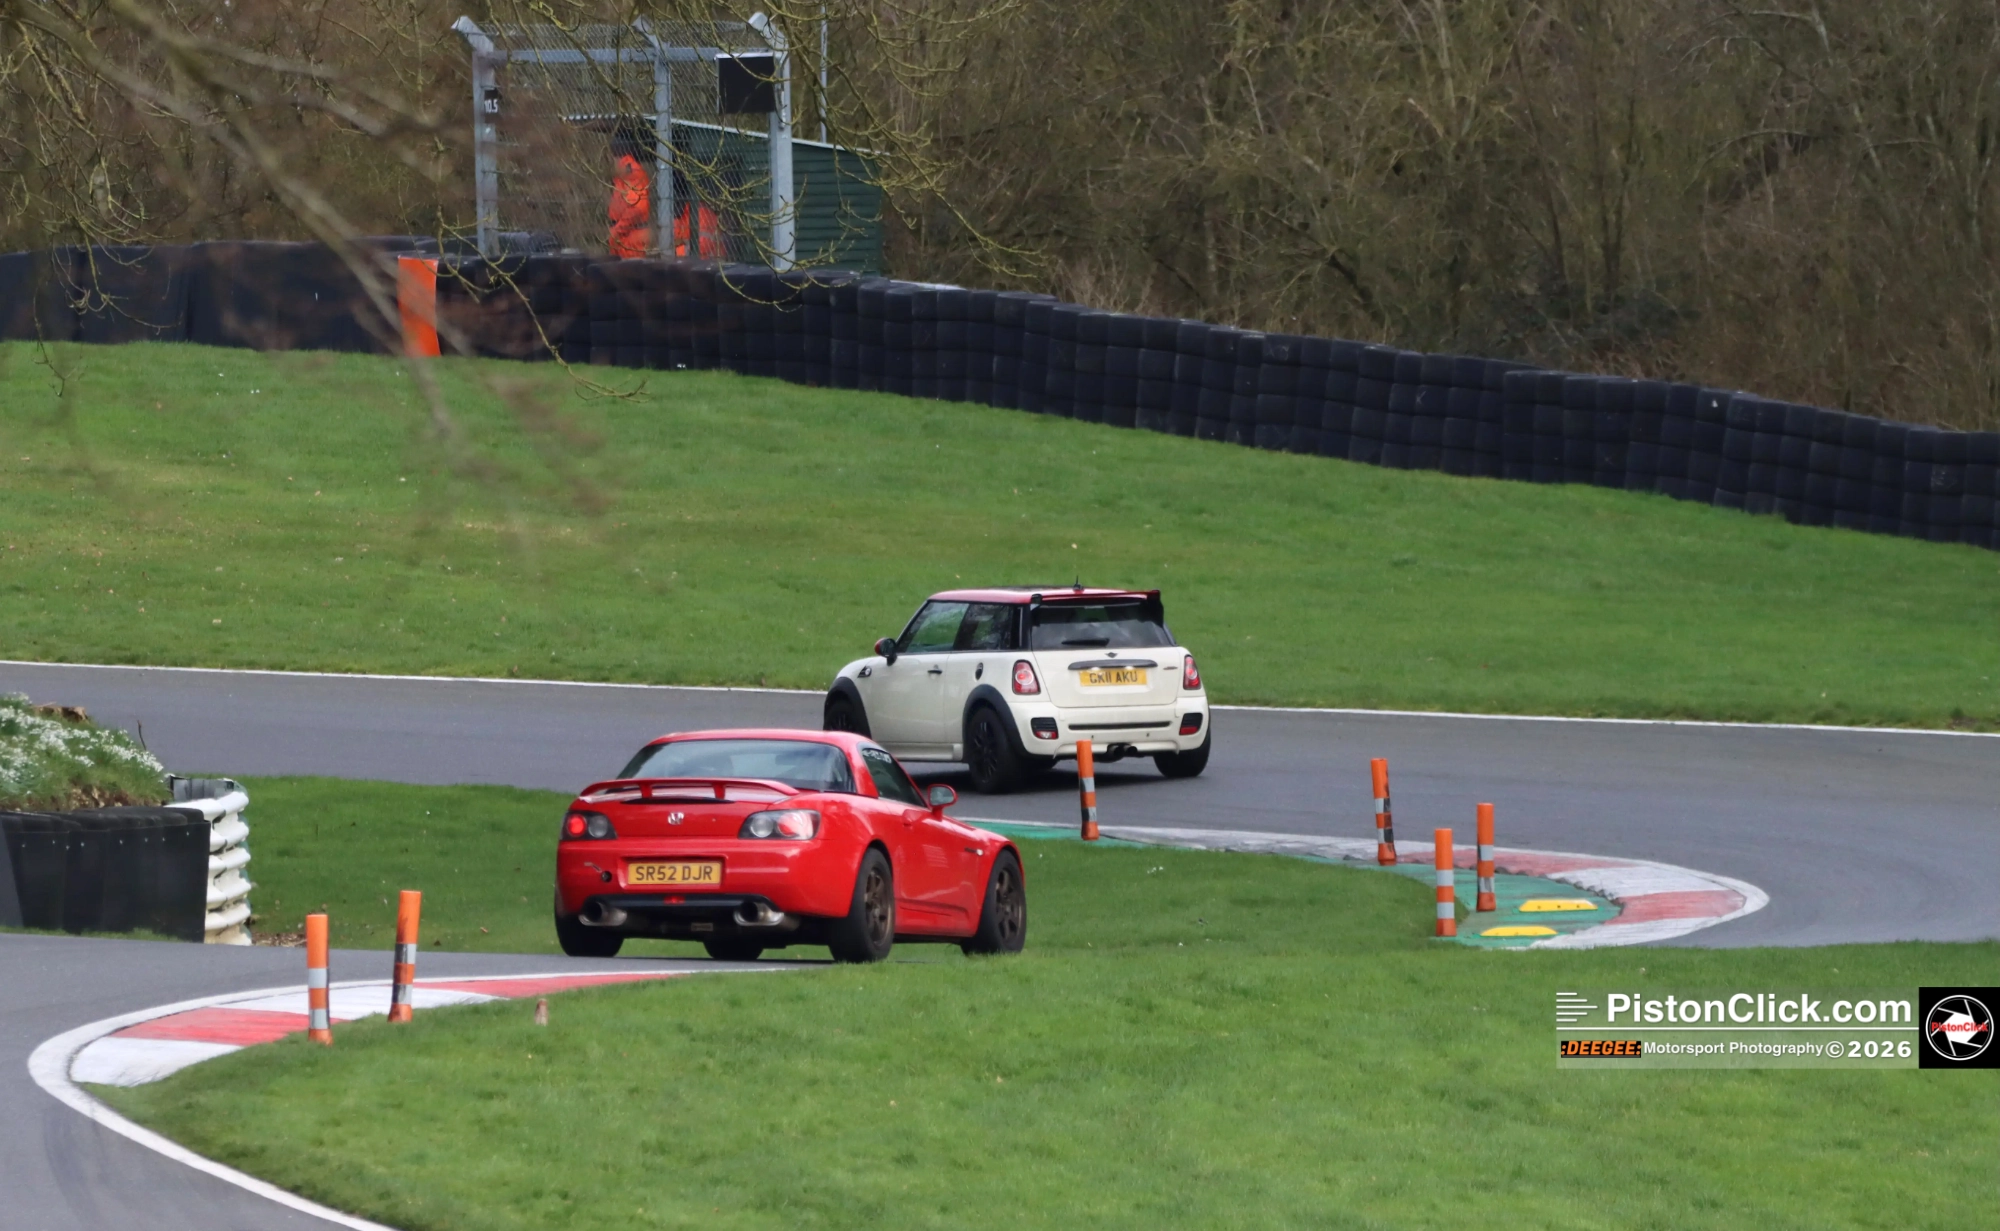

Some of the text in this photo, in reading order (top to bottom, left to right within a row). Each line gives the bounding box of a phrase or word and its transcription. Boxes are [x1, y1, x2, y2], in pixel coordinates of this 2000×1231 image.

[1116, 671, 1138, 683] AKU
[636, 865, 713, 881] SR52 DJR
